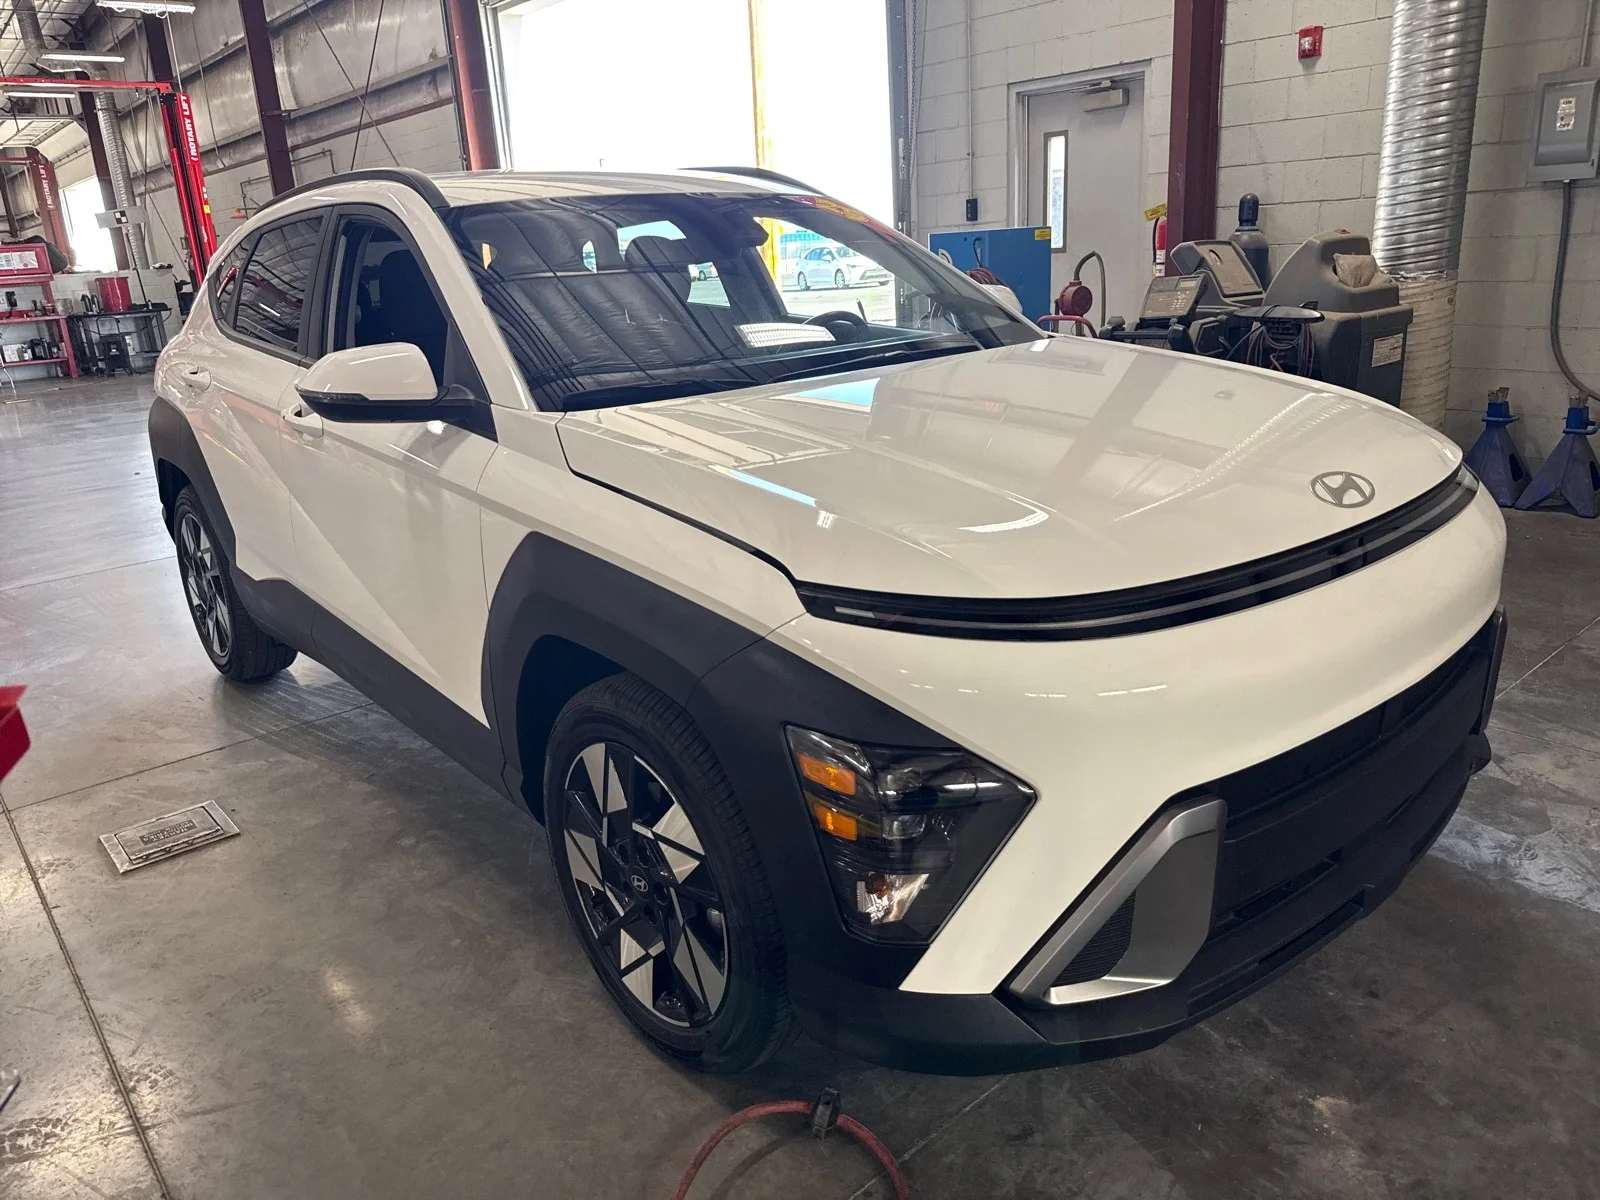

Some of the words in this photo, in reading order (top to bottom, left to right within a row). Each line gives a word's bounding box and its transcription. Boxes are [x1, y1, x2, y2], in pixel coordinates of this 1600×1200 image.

[180, 94, 190, 115] LIFT
[185, 116, 197, 156] ROTARY
[42, 179, 52, 205] ROTARY
